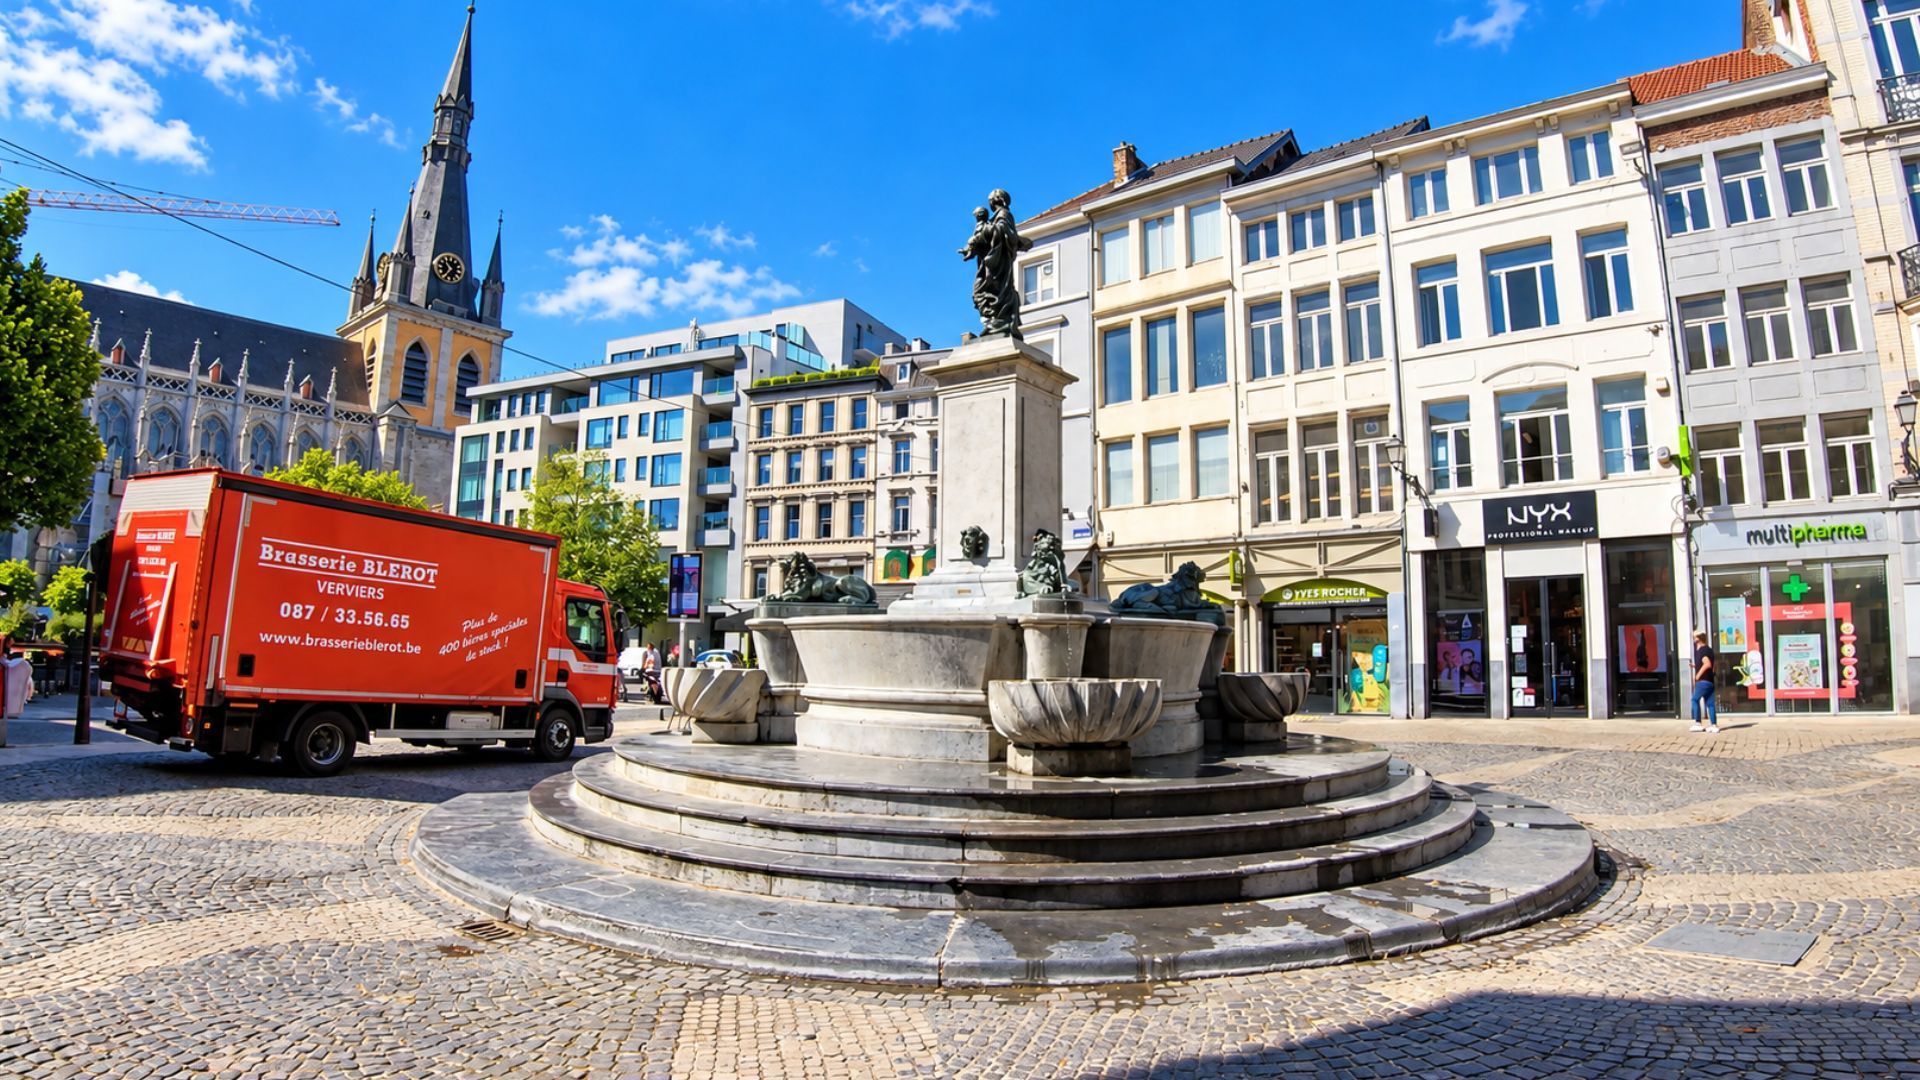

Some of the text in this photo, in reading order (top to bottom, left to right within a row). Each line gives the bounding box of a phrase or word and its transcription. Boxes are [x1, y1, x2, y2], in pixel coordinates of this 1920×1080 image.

[1507, 501, 1572, 529] NYX
[1487, 526, 1595, 539] PROFESSIONAL MAKEUP
[1746, 522, 1867, 548] multipharma
[260, 544, 437, 583] Brasserie BLEROT
[317, 580, 384, 599] VERVIERS
[1294, 587, 1367, 600] YVES ROCHER
[279, 602, 410, 629] 087 / 33.56.65
[462, 611, 498, 633] Plus de
[259, 632, 421, 655] www.brasserieblerot.be
[439, 640, 460, 655] 400
[465, 650, 477, 662] de
